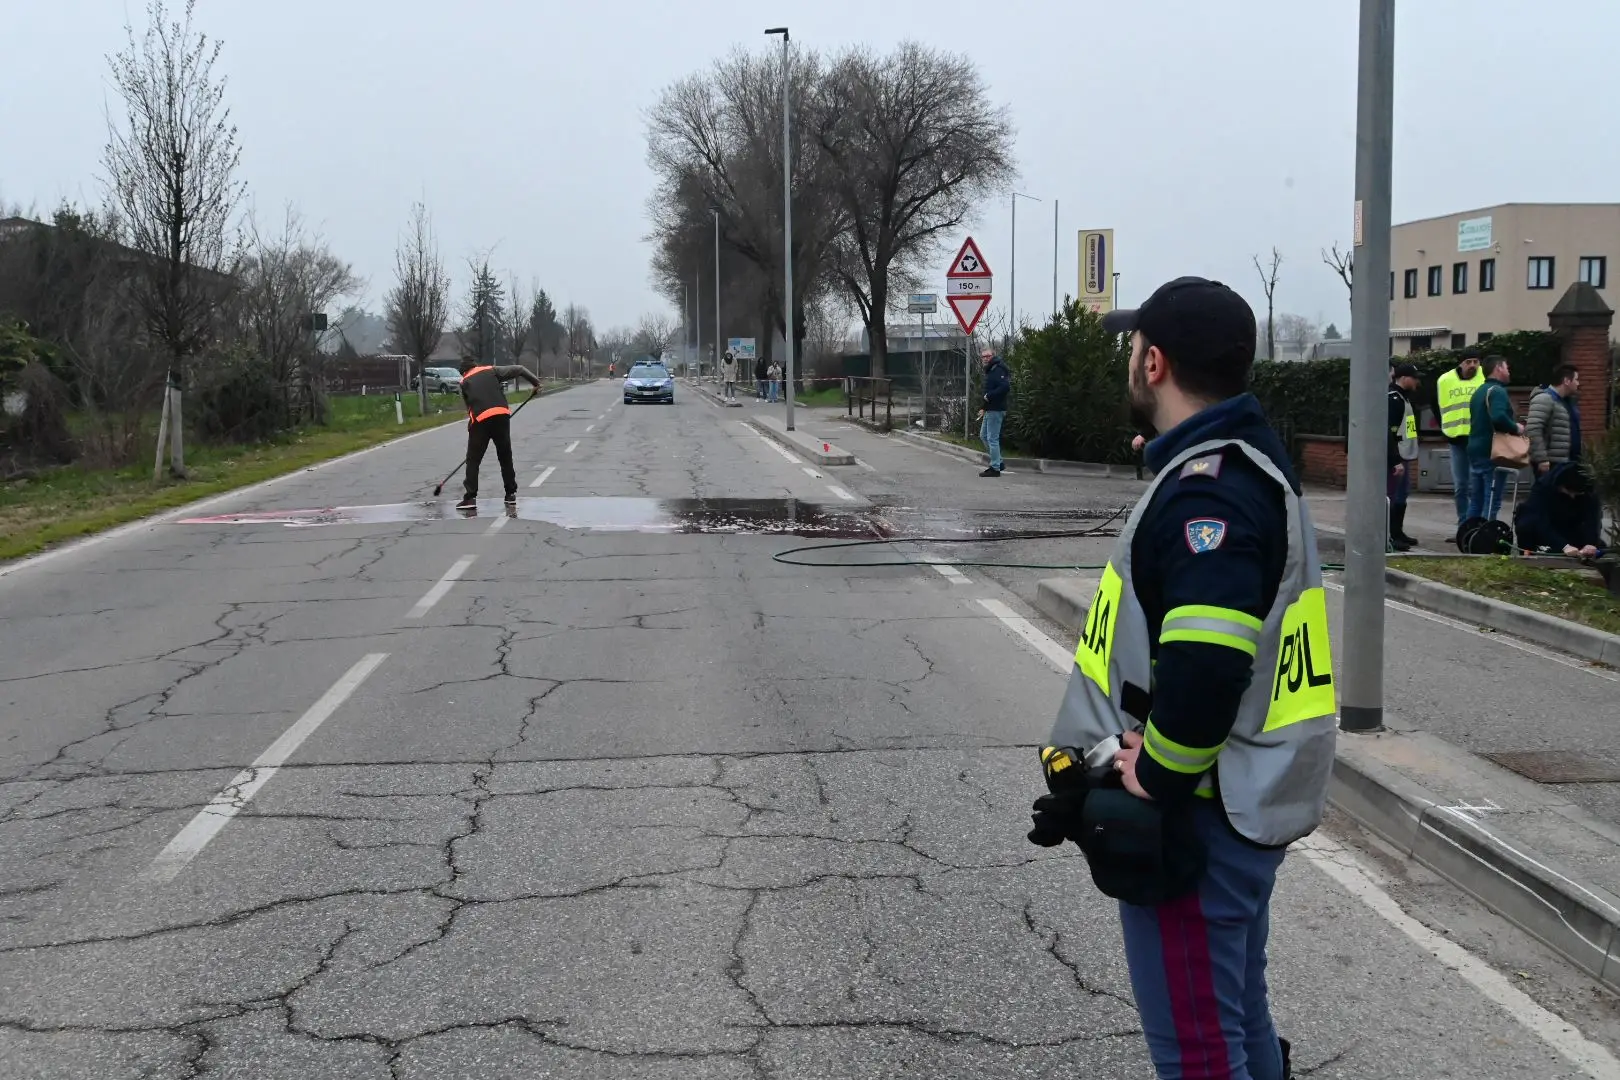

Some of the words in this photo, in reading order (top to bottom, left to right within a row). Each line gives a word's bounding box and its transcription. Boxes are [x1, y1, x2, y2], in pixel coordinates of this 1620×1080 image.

[958, 282, 974, 290] 150
[1449, 386, 1477, 399] POLIZ
[1273, 622, 1332, 702] POL
